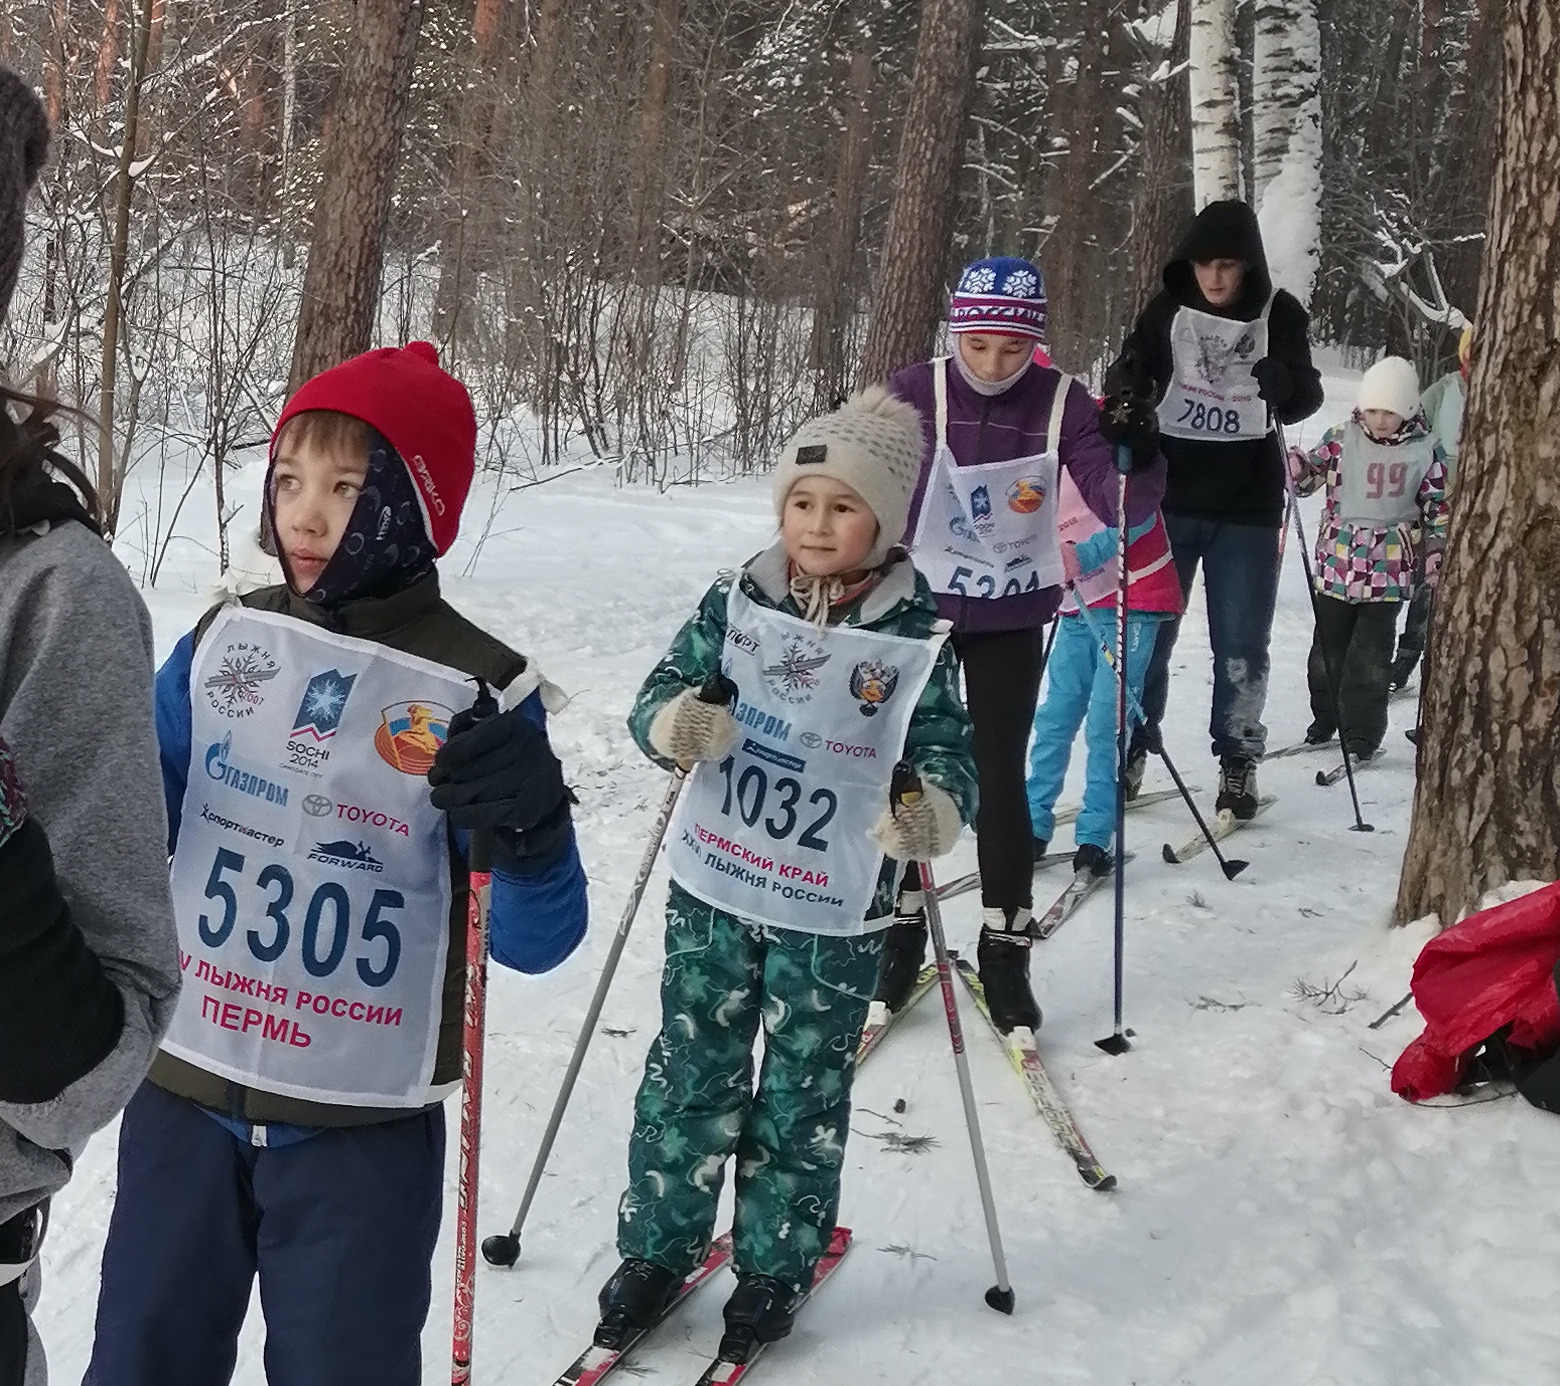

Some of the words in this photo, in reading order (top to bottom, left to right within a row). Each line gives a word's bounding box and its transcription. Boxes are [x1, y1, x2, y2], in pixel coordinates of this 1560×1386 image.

[1177, 398, 1240, 434] 7808
[1365, 462, 1408, 499] 99
[227, 643, 276, 669] ЛЫЖНЯ
[207, 691, 254, 718] РОССИИ
[737, 702, 793, 742] ЗПРОМ
[286, 740, 330, 761] SOCHI
[289, 753, 319, 769] 2014
[825, 739, 877, 759] TOYOTA
[224, 765, 289, 807] ГАЗПРОМ
[719, 753, 838, 852] 1032
[337, 803, 409, 837] TOYOTA
[307, 852, 385, 873] FORWARD
[694, 823, 774, 872] ПЕРМСКИЙ
[779, 864, 830, 888] КРАЙ
[704, 853, 767, 889] ЛЫЖНЯ
[772, 881, 845, 907] РОССИИ
[198, 845, 405, 988] 5305
[195, 959, 288, 1006] ЛЫЖНЯ
[296, 990, 403, 1027] РОССИИ
[201, 995, 312, 1049] ПЕРМЬ
